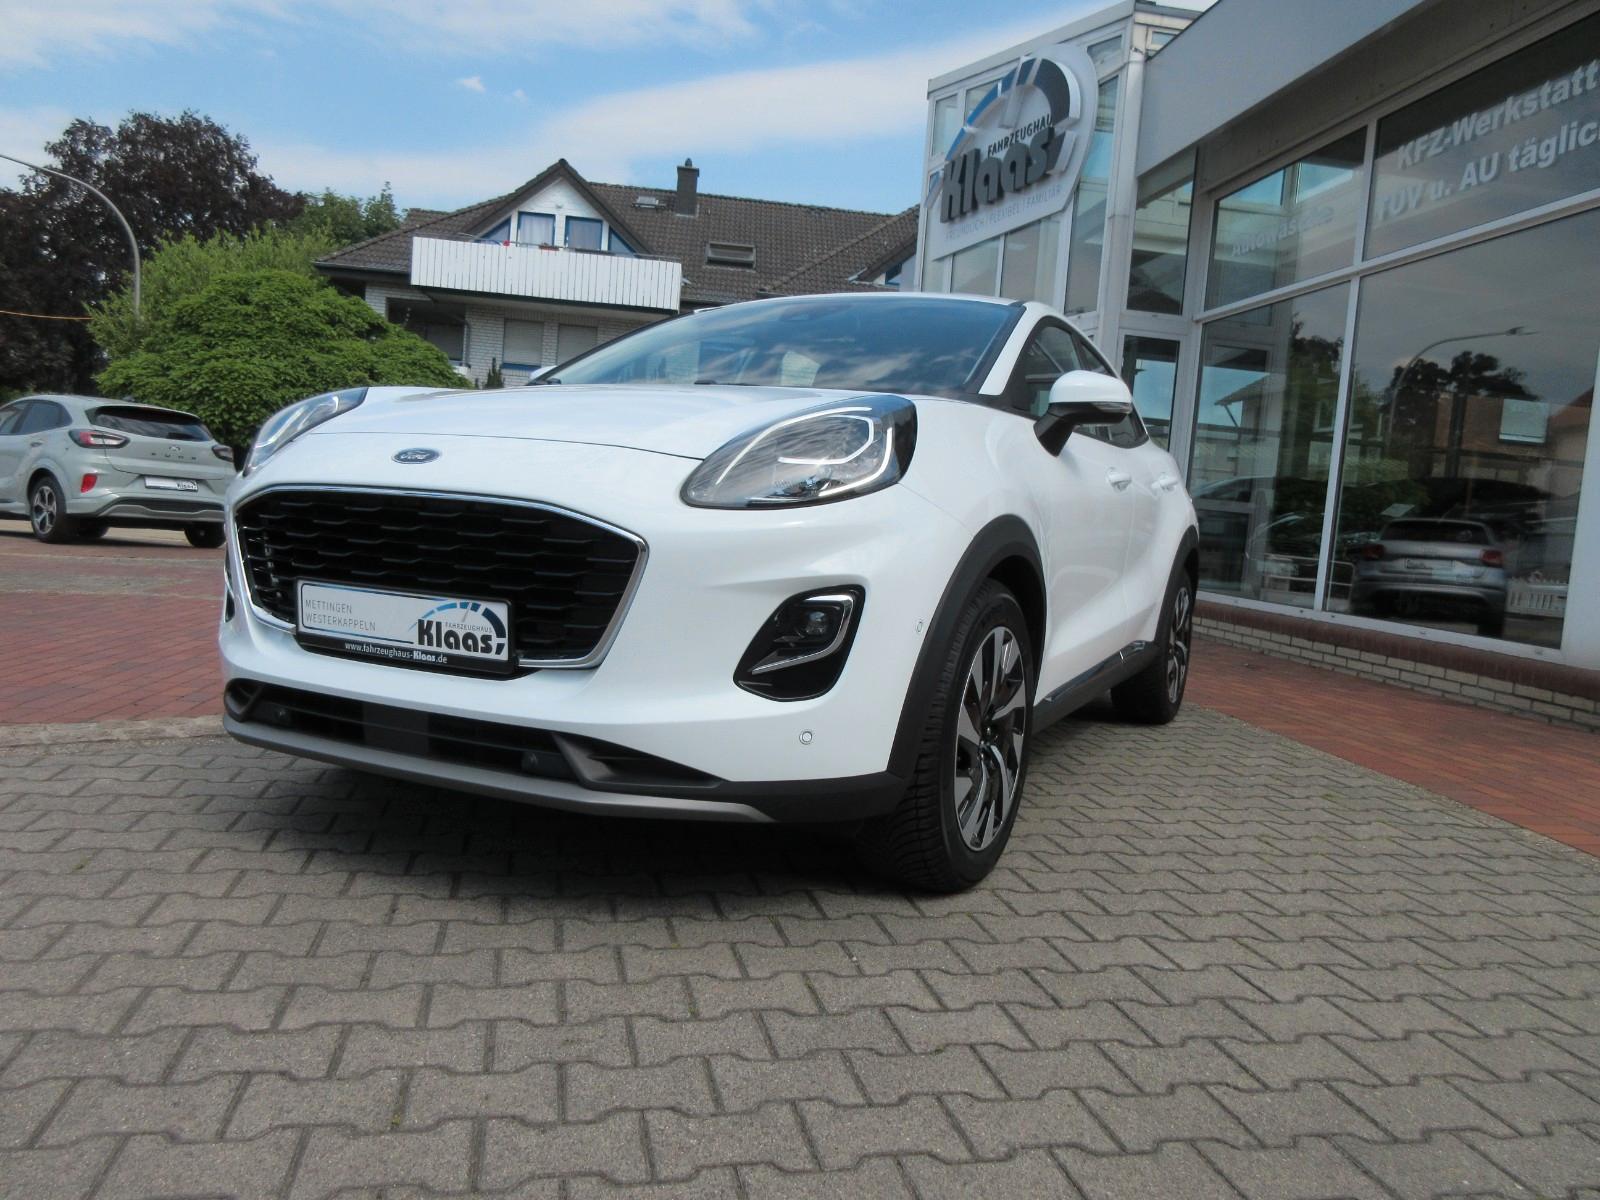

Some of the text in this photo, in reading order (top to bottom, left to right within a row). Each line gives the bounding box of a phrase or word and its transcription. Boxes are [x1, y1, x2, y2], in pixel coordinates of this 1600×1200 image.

[1397, 59, 1600, 170] KFZ-Werkstatt
[987, 113, 1053, 157] FAHRZEUGHAU
[1459, 151, 1500, 192] AU
[1508, 120, 1600, 172] täglic
[940, 126, 1055, 224] Klaas
[304, 599, 352, 614] METTINGEN
[304, 612, 376, 631] WESTERKAPPELN
[418, 618, 493, 654] Klaas
[445, 622, 493, 633] FAHRZEUGHAUS
[345, 641, 447, 663] www.fahrzeughaus-Klaas.de
